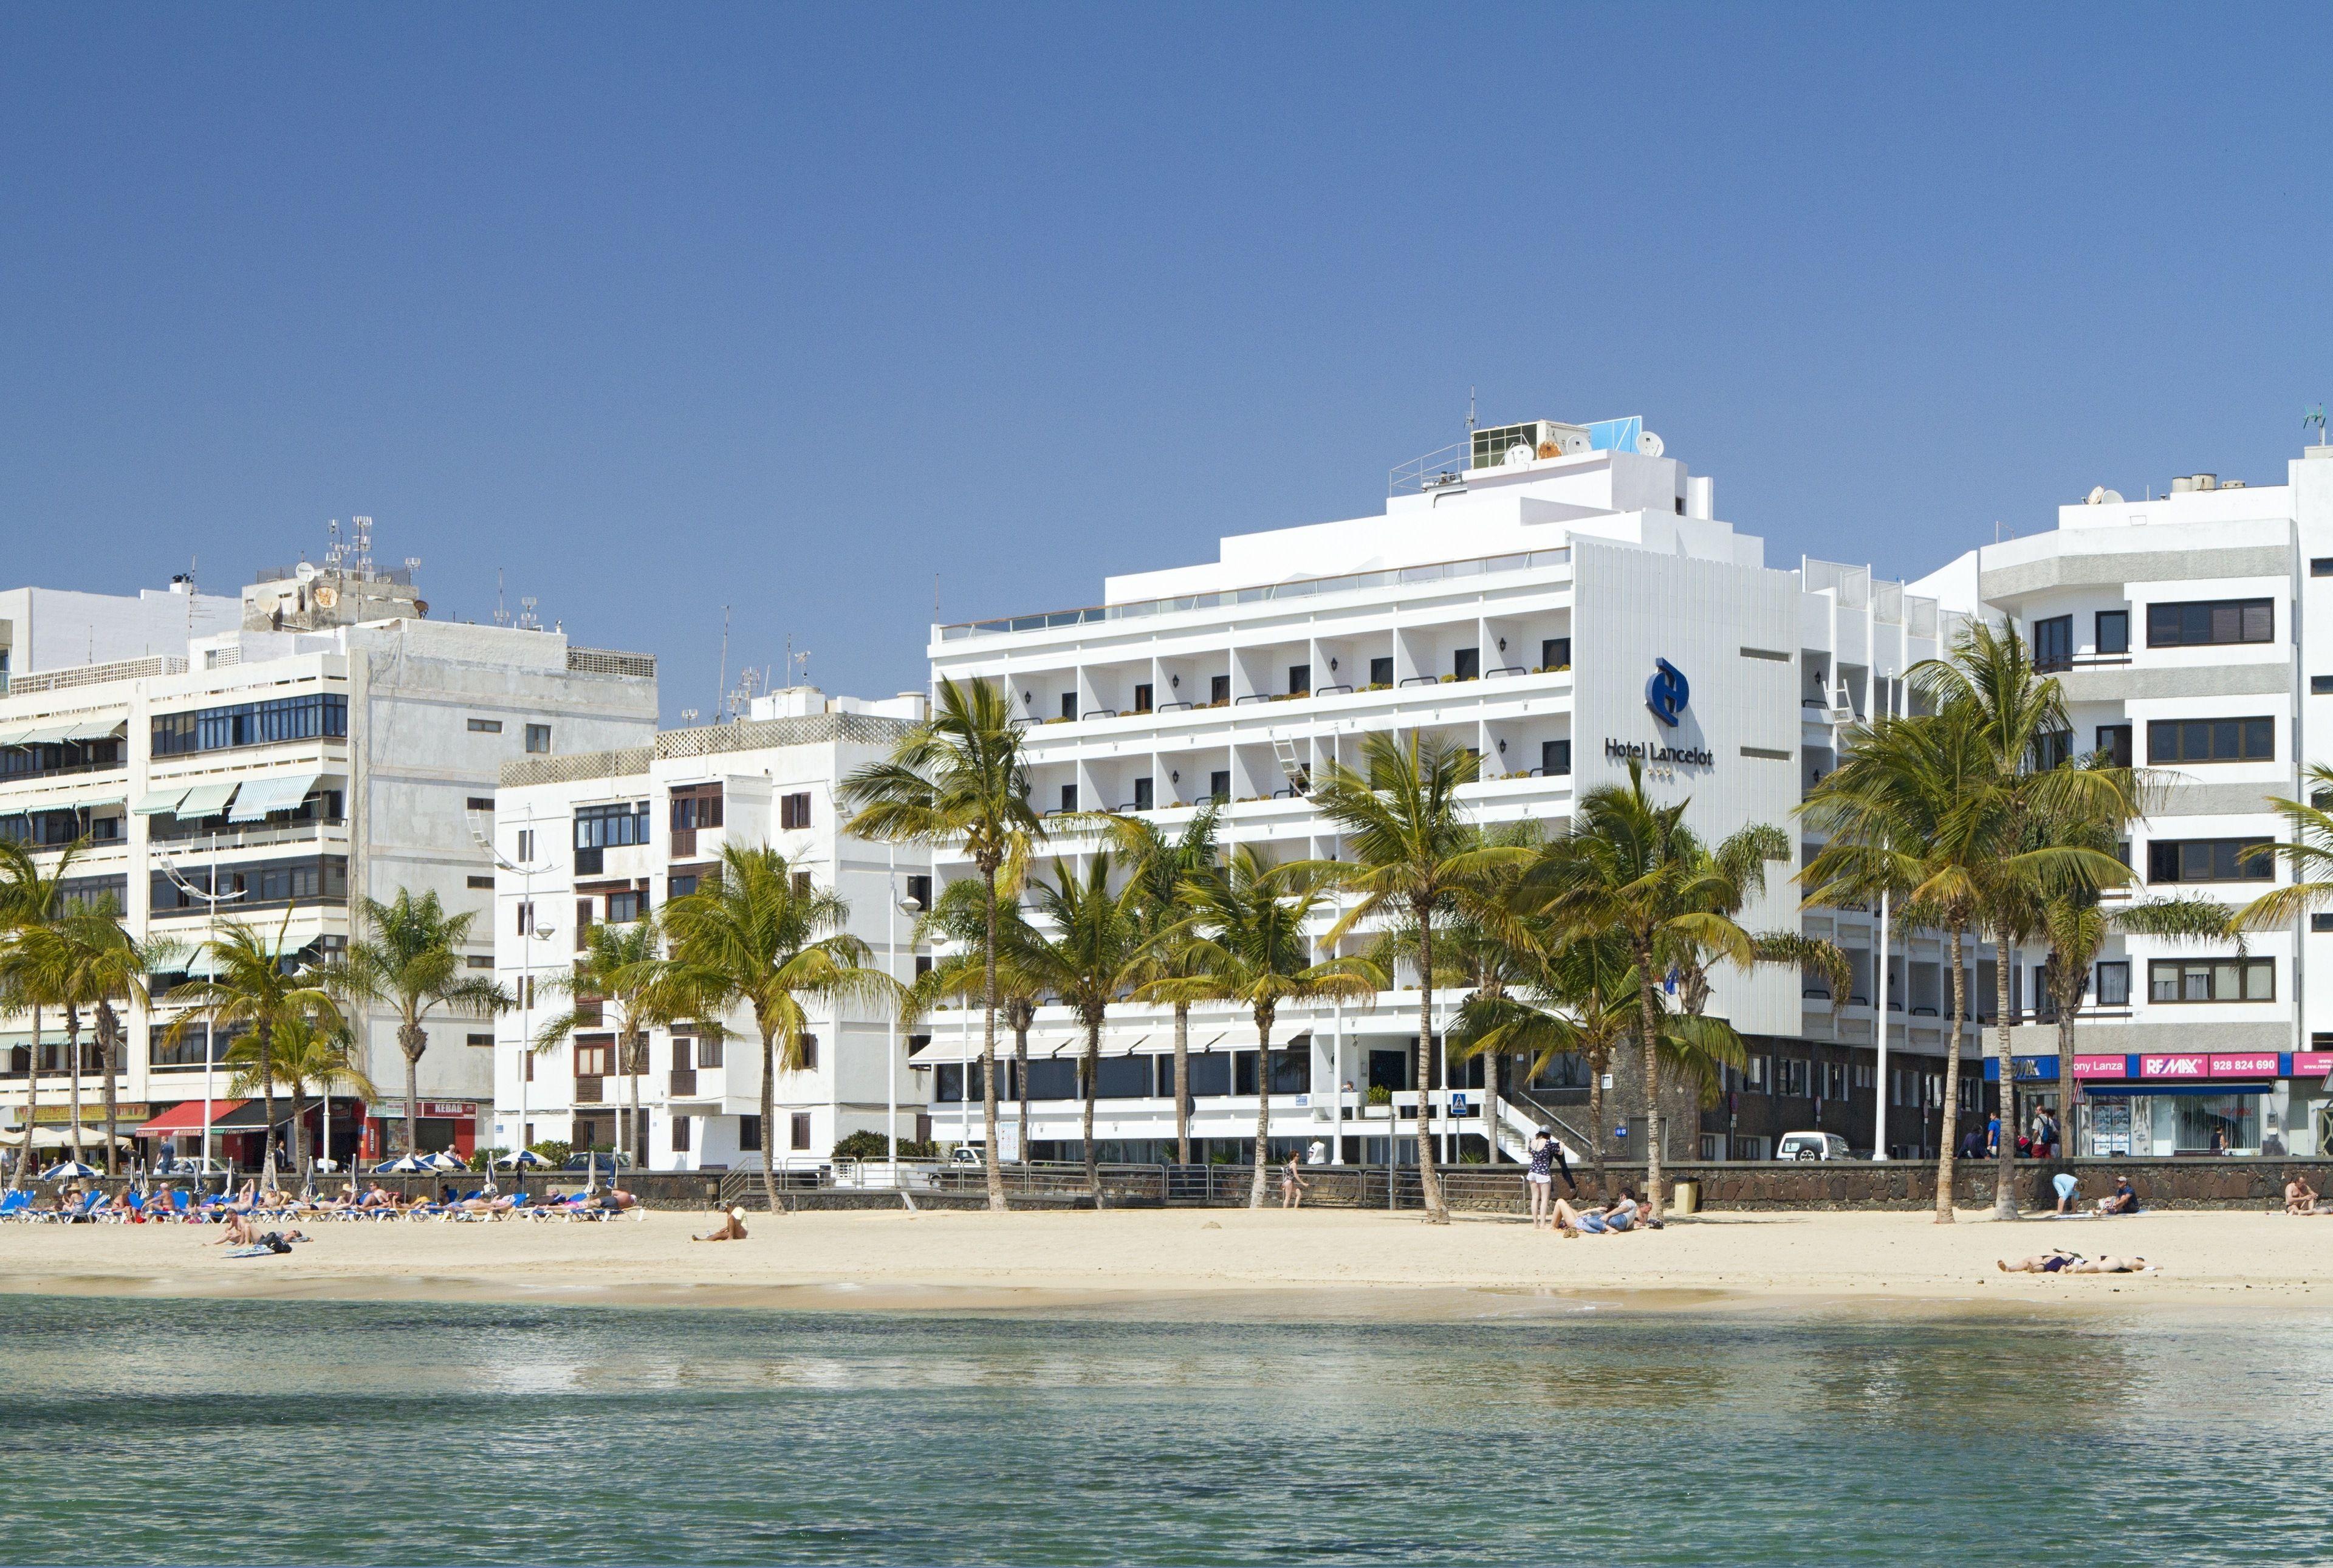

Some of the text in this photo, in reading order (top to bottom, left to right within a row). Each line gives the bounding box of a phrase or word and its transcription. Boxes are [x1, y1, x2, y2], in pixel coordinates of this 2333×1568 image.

[1605, 738, 1713, 765] Hotel Lancelot
[2074, 1061, 2123, 1073] ony Lanza
[2213, 1060, 2275, 1070] 928 824 690
[435, 1103, 463, 1113] KEBAB
